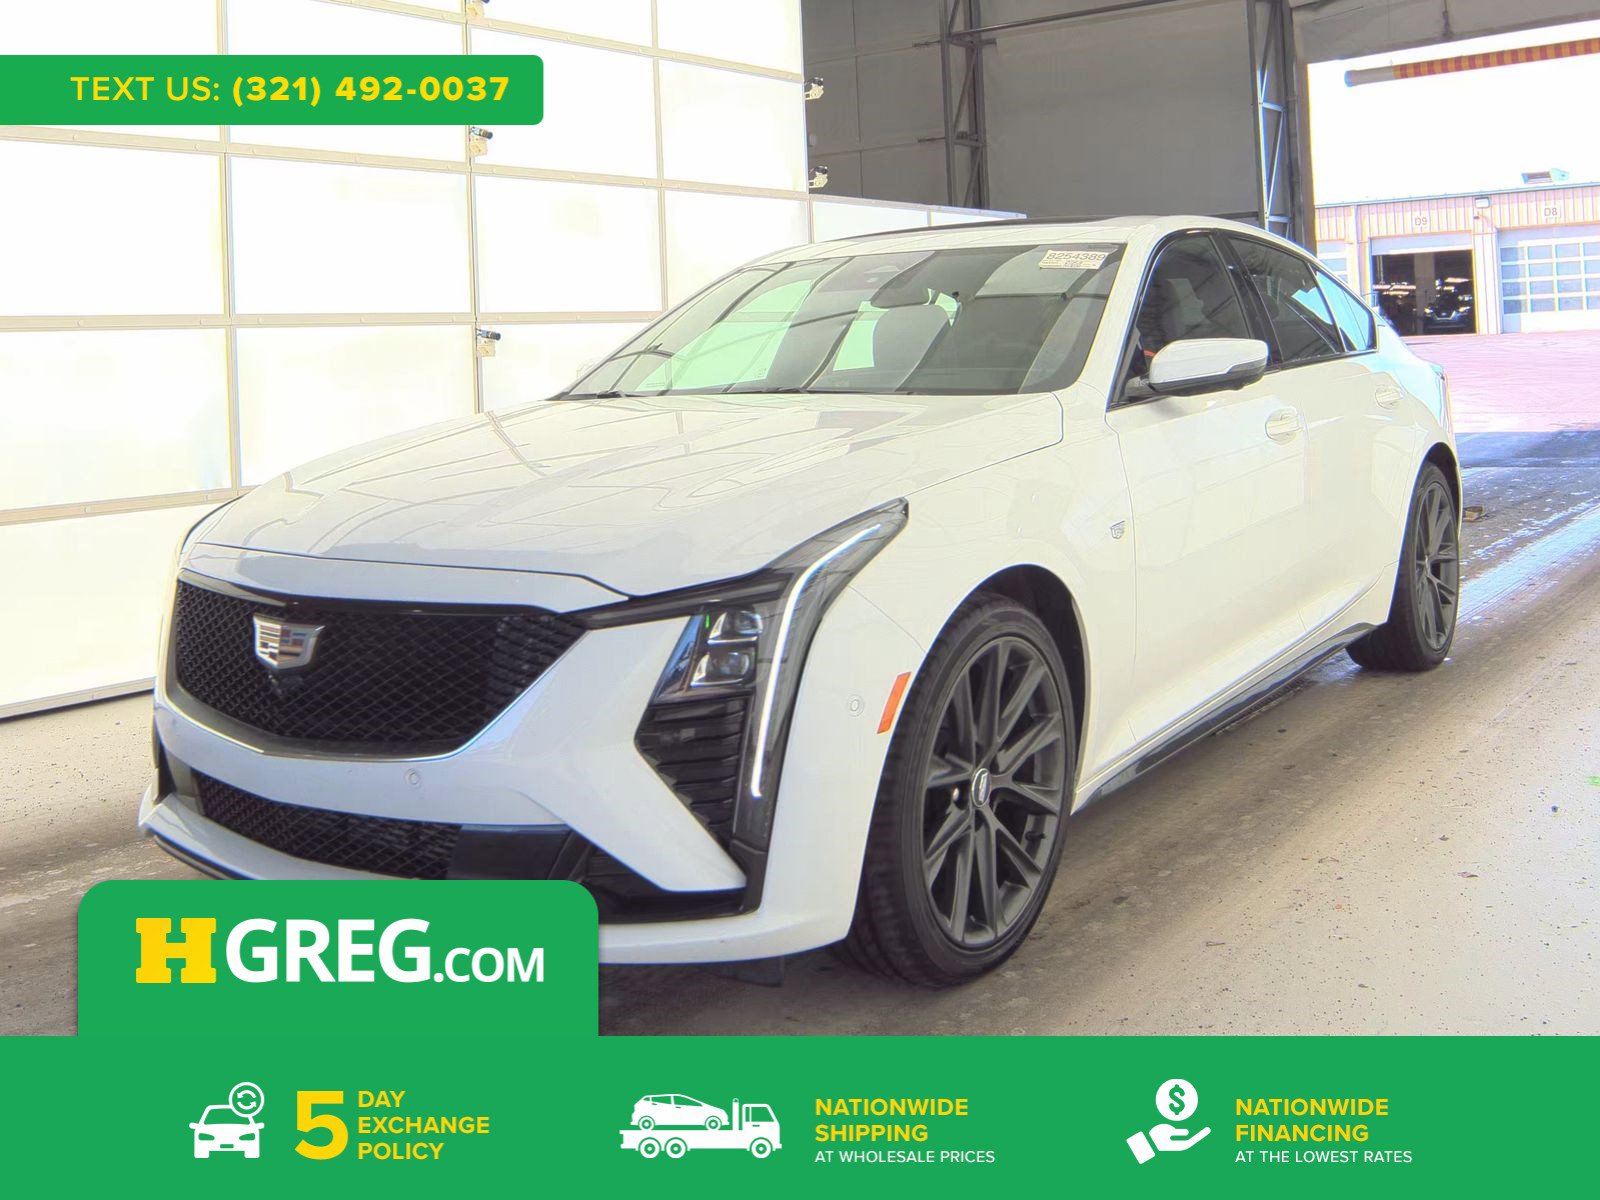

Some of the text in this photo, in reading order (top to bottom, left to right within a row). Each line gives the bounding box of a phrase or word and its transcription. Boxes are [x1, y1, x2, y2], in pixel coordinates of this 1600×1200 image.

[1543, 207, 1558, 217] D8
[1414, 217, 1428, 226] D9
[1046, 252, 1106, 261] 8254389
